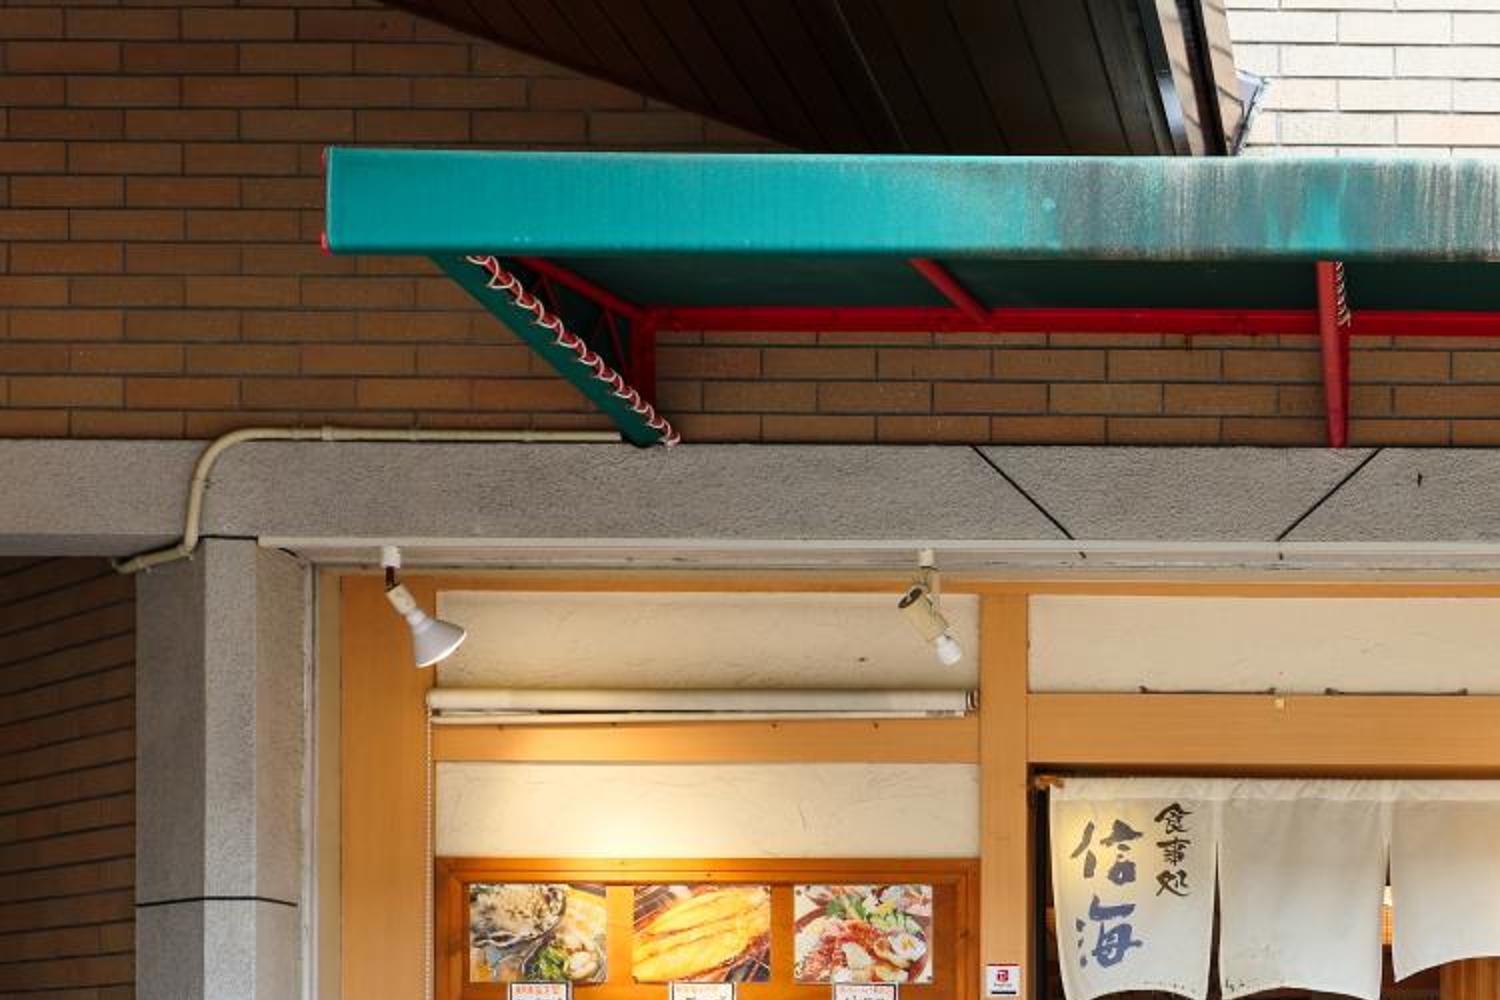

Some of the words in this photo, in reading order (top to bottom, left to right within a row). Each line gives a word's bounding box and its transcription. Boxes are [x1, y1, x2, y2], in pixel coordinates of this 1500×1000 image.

[1071, 819, 1143, 969] 信海
[1154, 803, 1193, 897] 食事処
